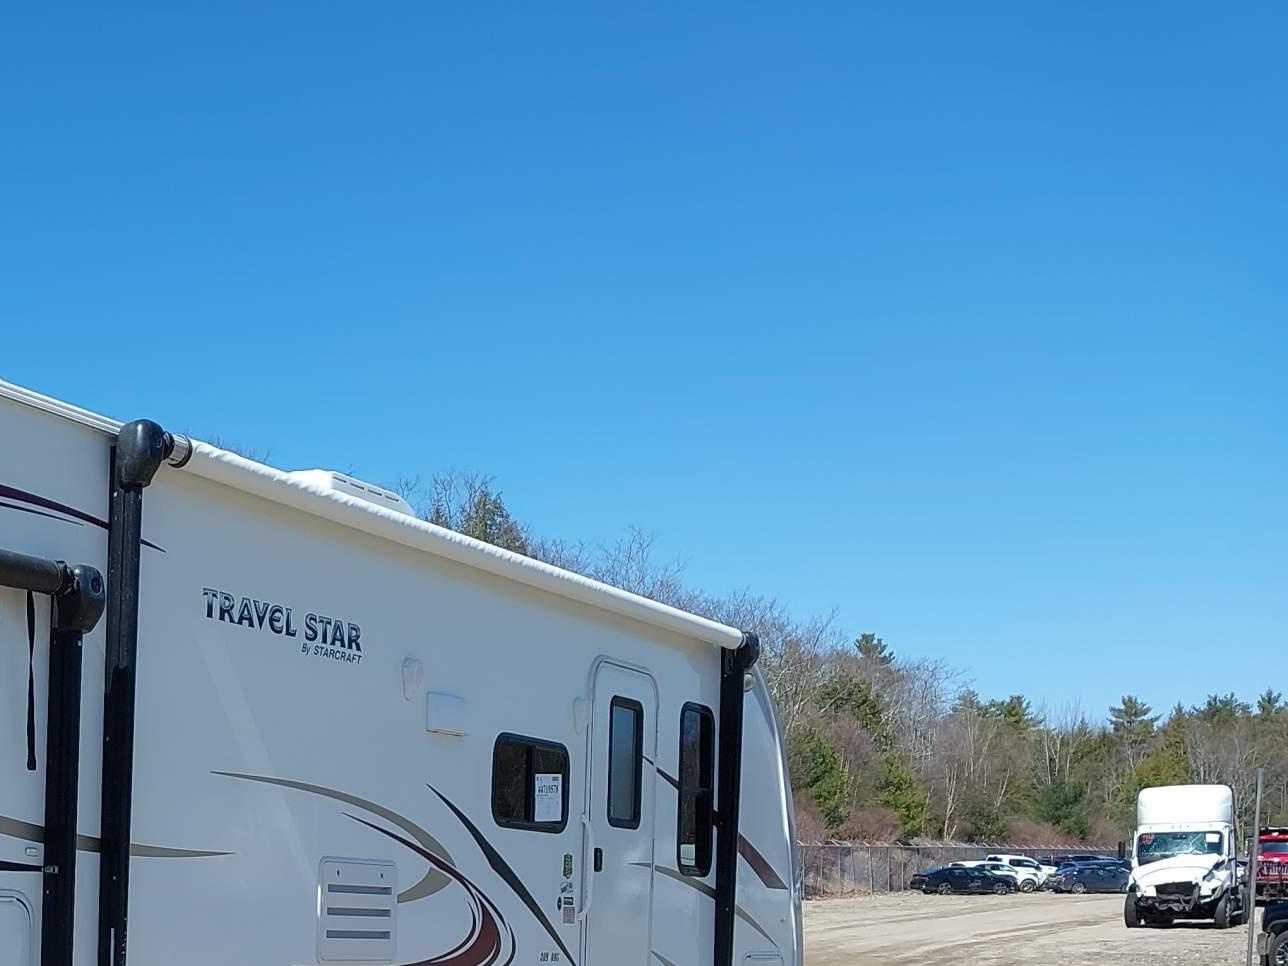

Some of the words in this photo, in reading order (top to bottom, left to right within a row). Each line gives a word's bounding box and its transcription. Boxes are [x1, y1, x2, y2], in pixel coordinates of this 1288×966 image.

[202, 587, 297, 638] TRAVEL
[304, 613, 362, 652] STAR
[301, 643, 311, 656] By
[313, 645, 363, 665] STARCRAFT
